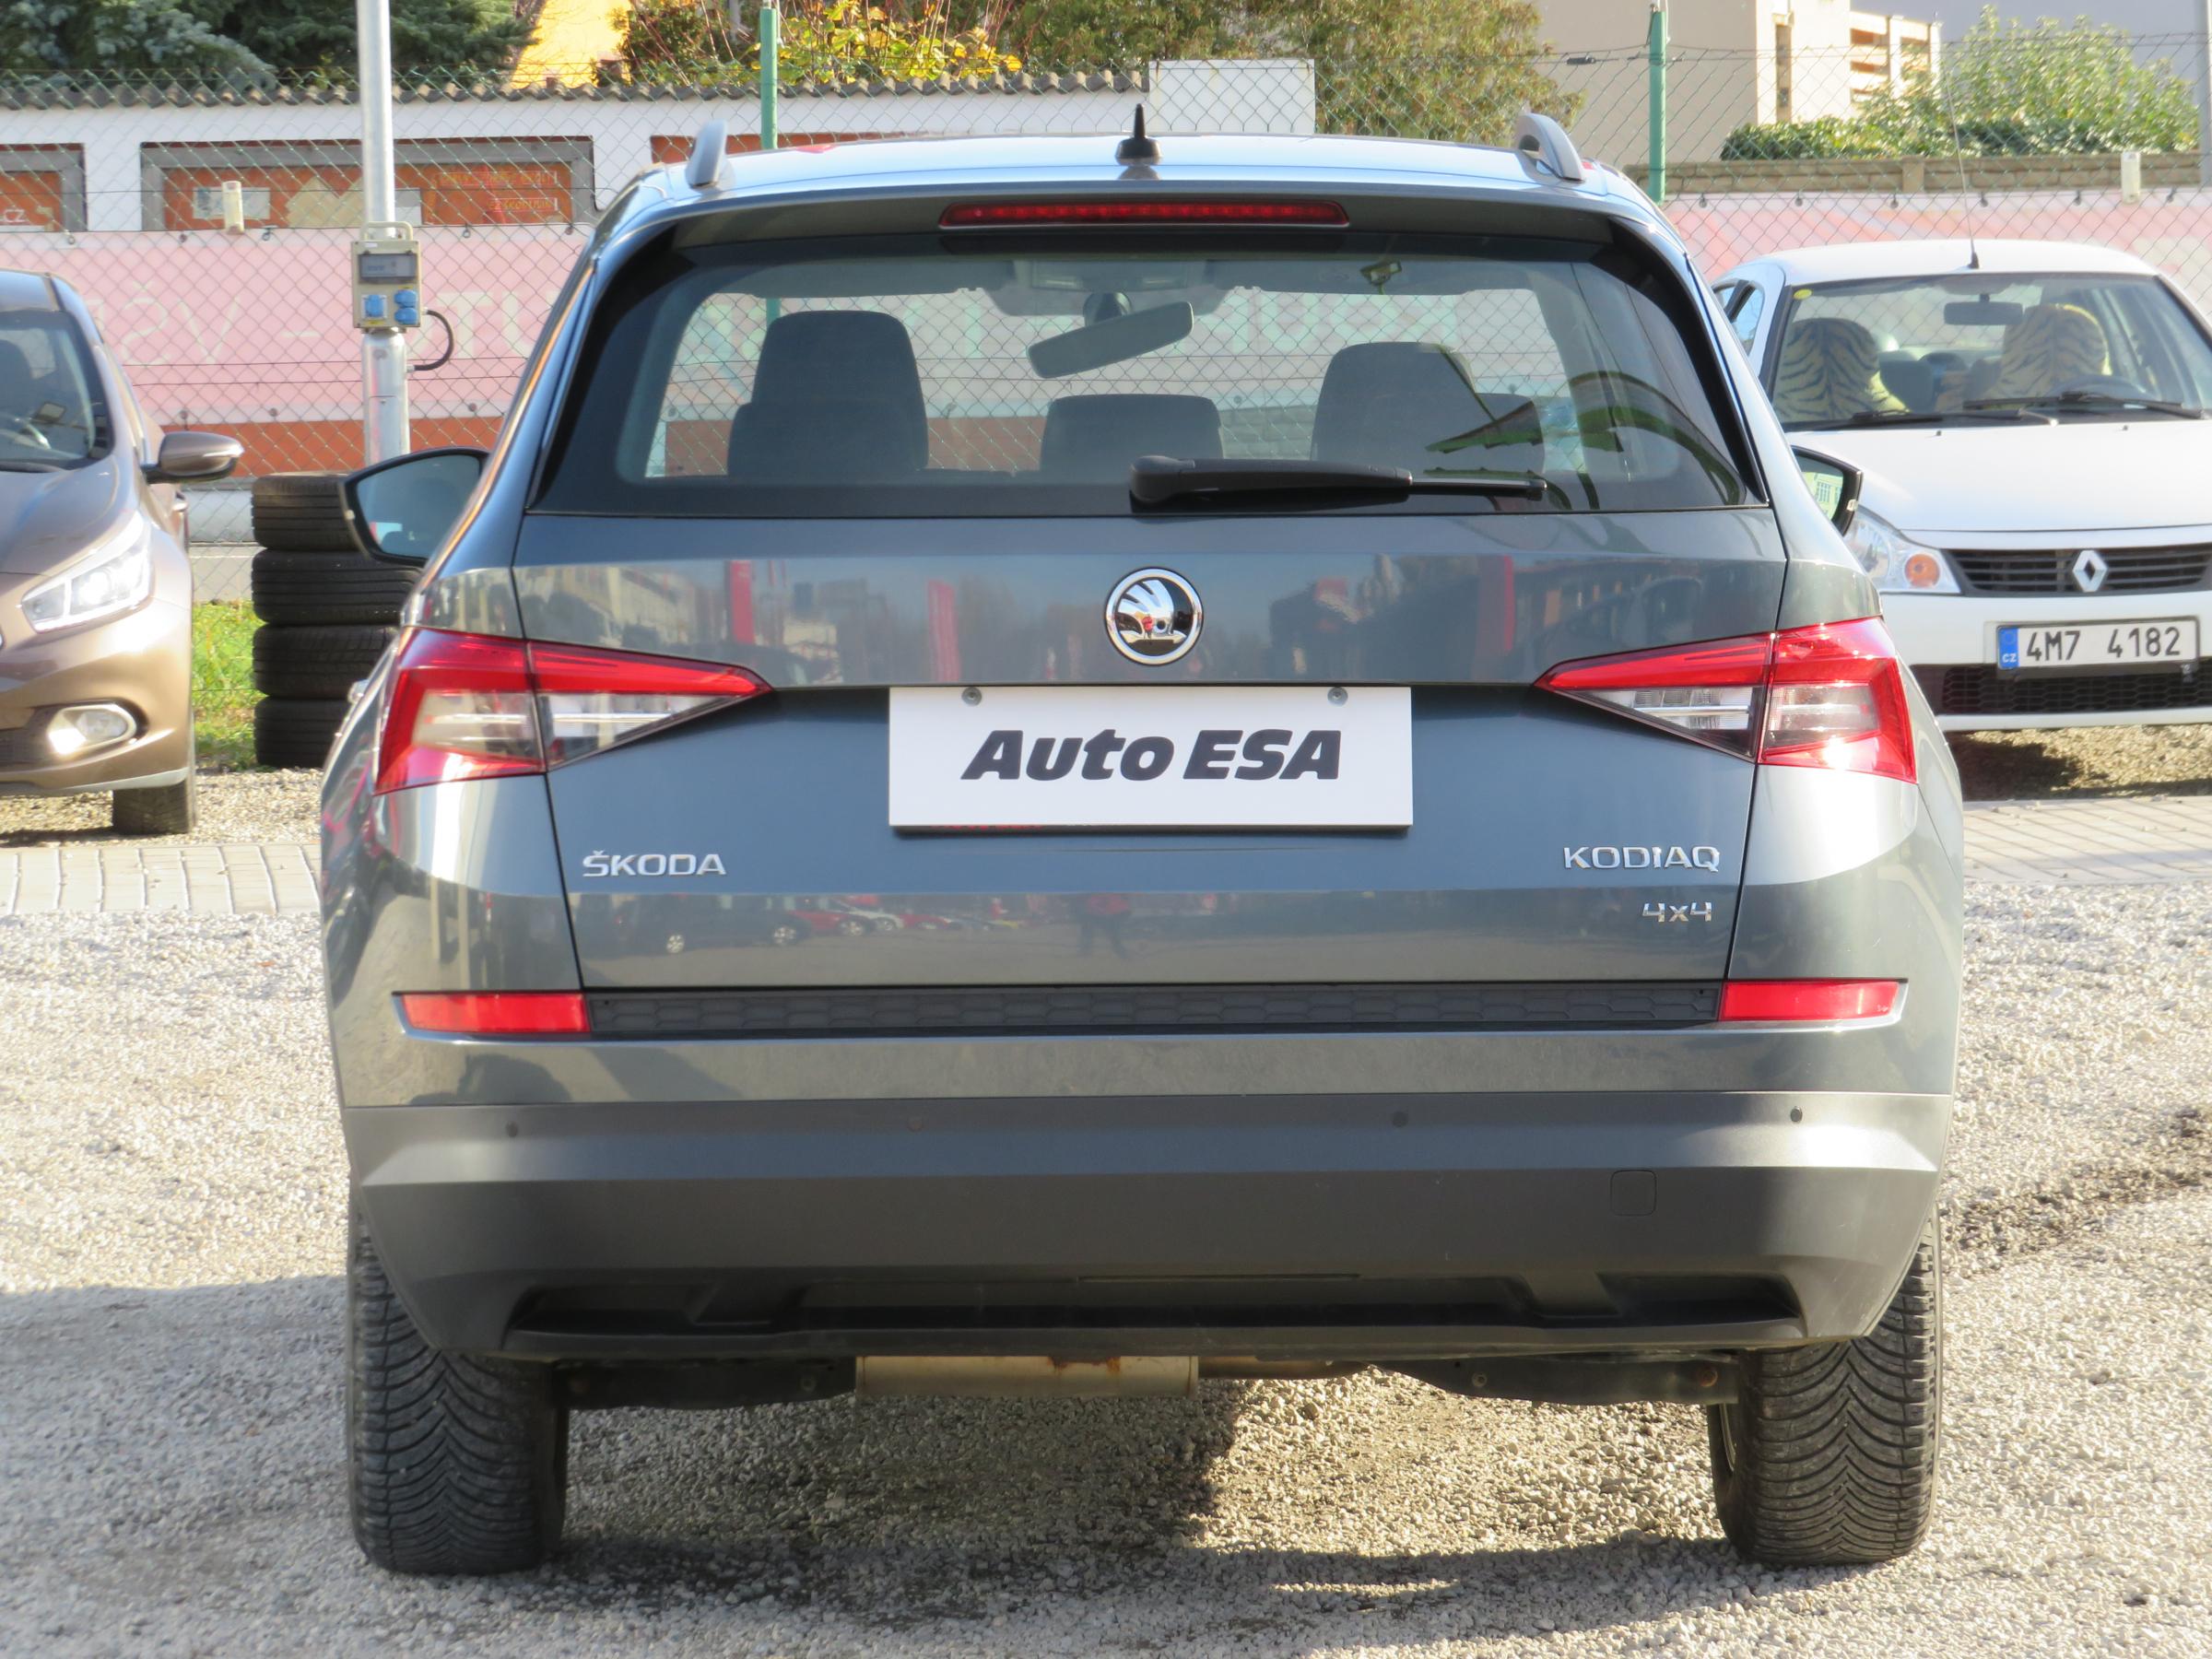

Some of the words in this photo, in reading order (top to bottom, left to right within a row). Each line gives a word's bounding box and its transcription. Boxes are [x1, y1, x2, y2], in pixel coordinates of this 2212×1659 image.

[2027, 629, 2080, 661] 4M7
[2107, 627, 2181, 658] 4182
[2002, 653, 2017, 663] CZ
[960, 728, 1174, 782] Auto
[1182, 729, 1342, 782] ESA
[582, 850, 727, 877] ŠKODA
[1562, 846, 1721, 872] KODIAQ
[1641, 901, 1712, 923] 4x4
